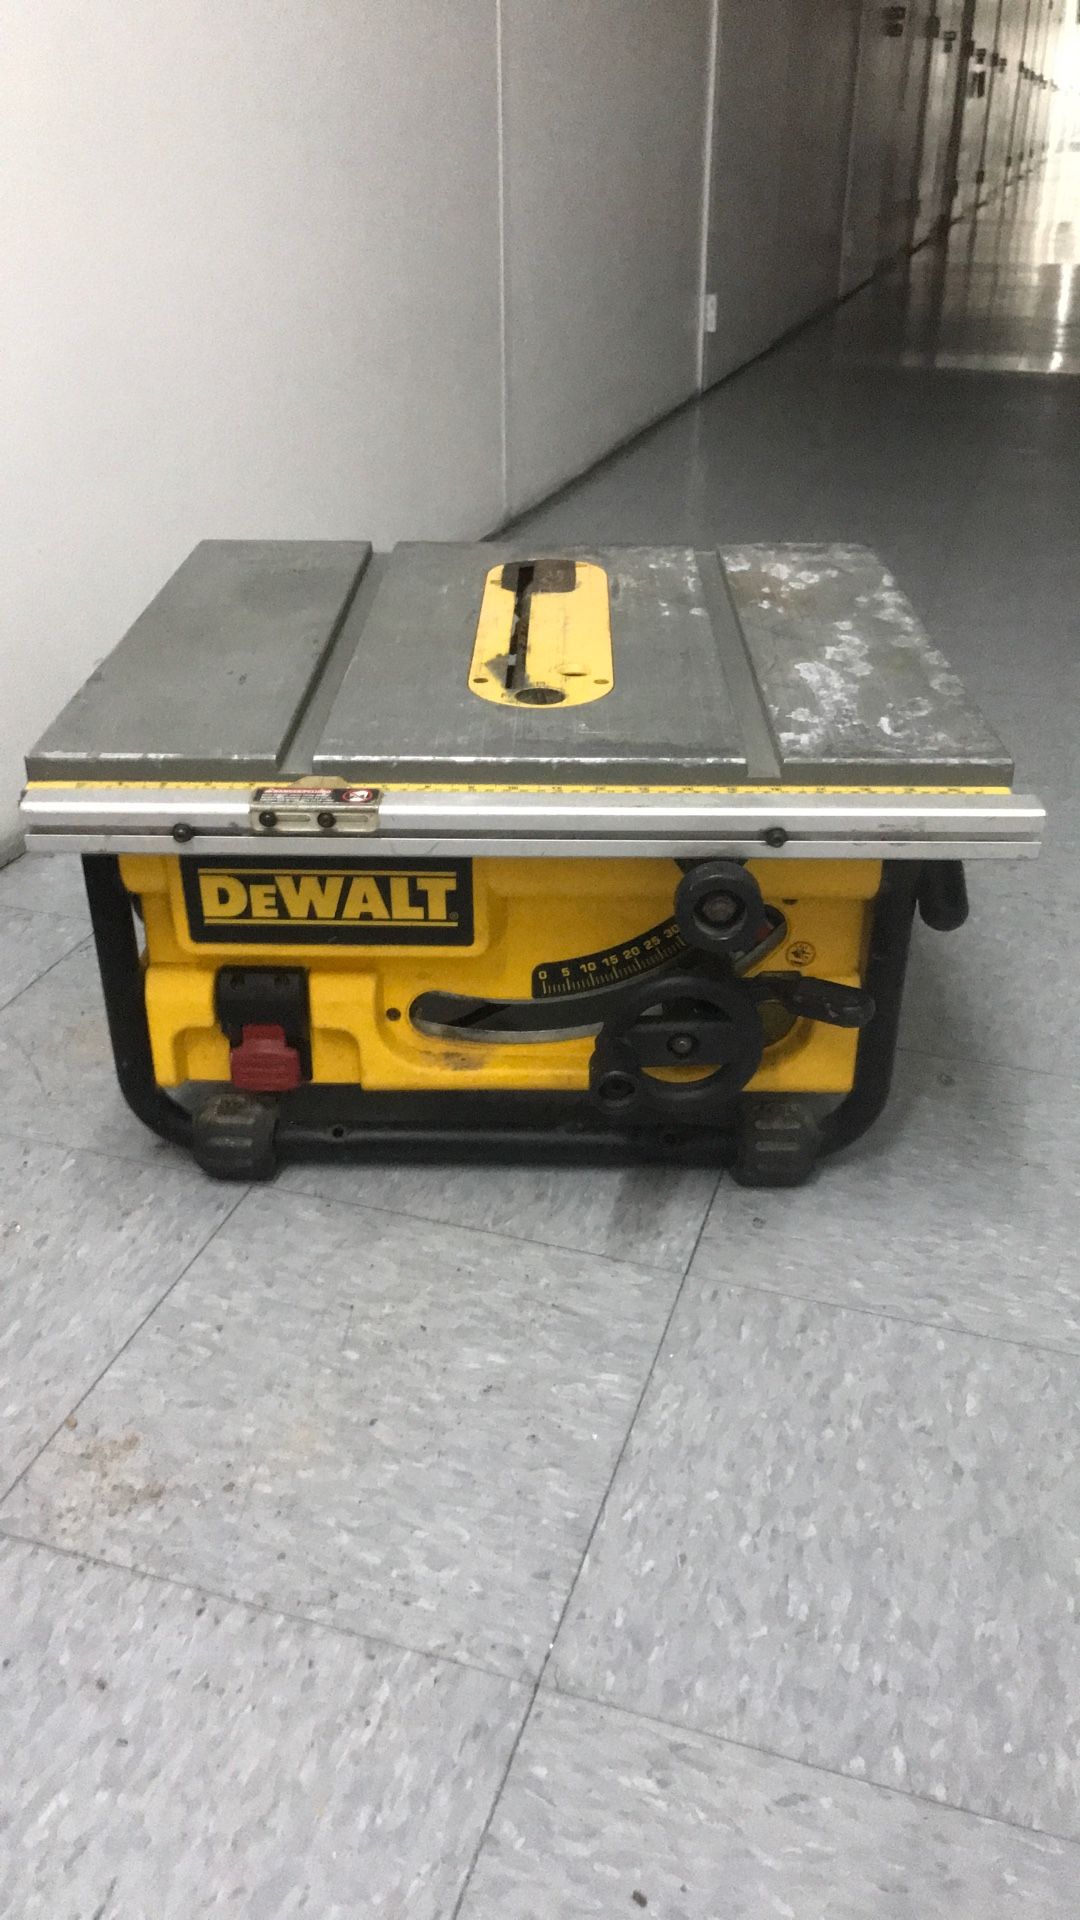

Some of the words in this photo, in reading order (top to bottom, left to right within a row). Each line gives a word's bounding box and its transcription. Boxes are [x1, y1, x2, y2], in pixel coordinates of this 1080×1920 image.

[538, 970, 548, 980] 0
[561, 967, 571, 977] 5
[580, 962, 597, 973] 10
[602, 955, 619, 966] 15
[622, 946, 641, 960] 20
[643, 936, 661, 950] 25
[663, 924, 681, 938] 30
